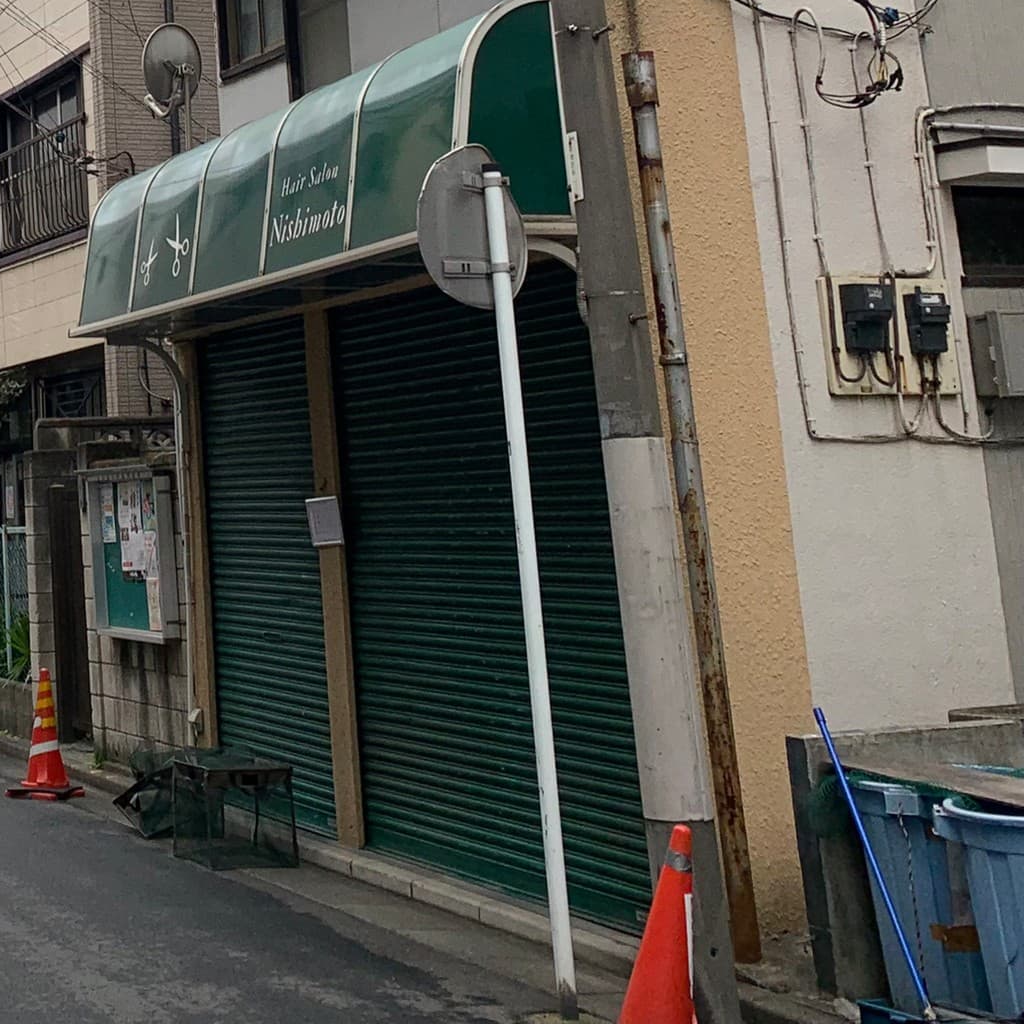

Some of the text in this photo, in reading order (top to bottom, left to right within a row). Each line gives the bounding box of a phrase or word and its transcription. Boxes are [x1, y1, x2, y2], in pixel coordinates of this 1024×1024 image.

[281, 162, 339, 197] Hair Salon
[269, 200, 346, 247] Nishimoto
